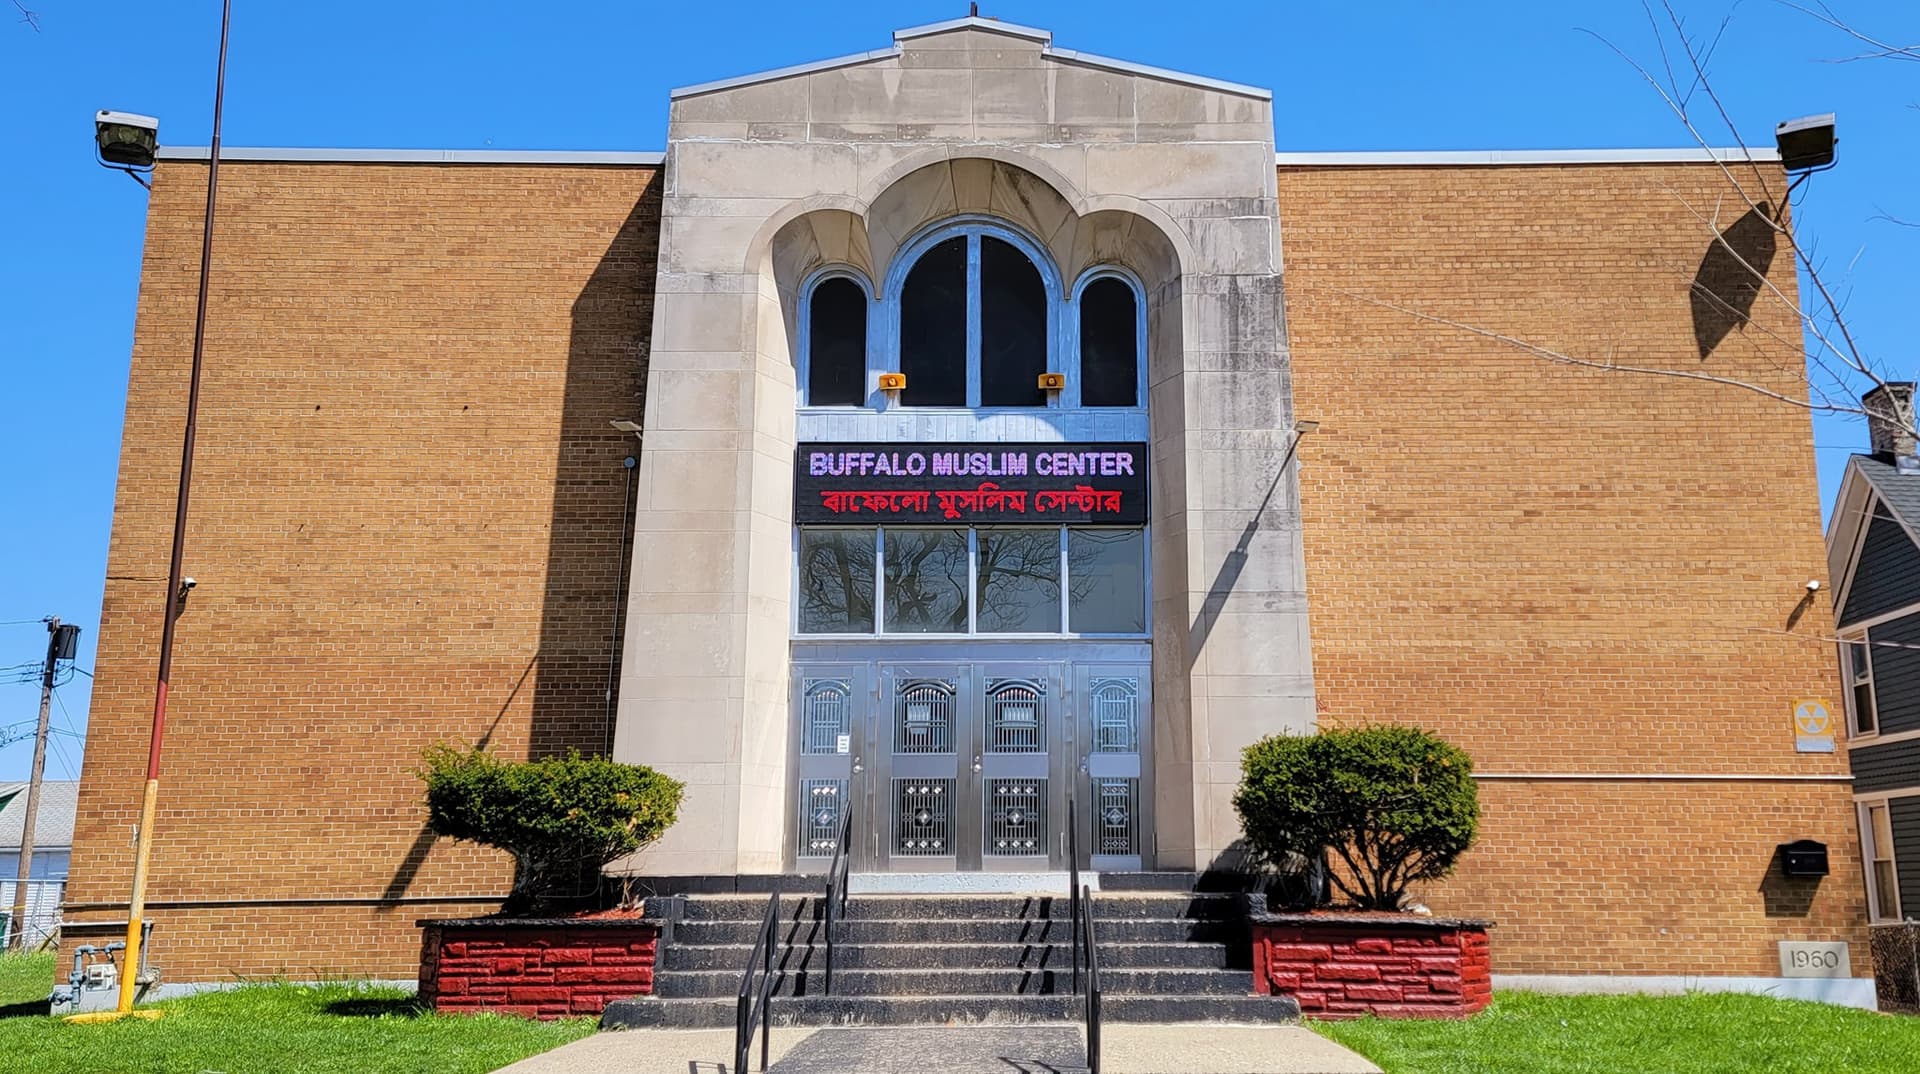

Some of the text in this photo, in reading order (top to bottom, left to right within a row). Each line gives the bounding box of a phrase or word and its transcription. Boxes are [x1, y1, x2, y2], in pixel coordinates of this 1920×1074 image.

[809, 452, 1135, 476] BUFFALO MUSLIM CENTER
[820, 482, 1122, 519] বাফেলো মুসলিম সেন্টার
[1791, 950, 1839, 969] 1960
